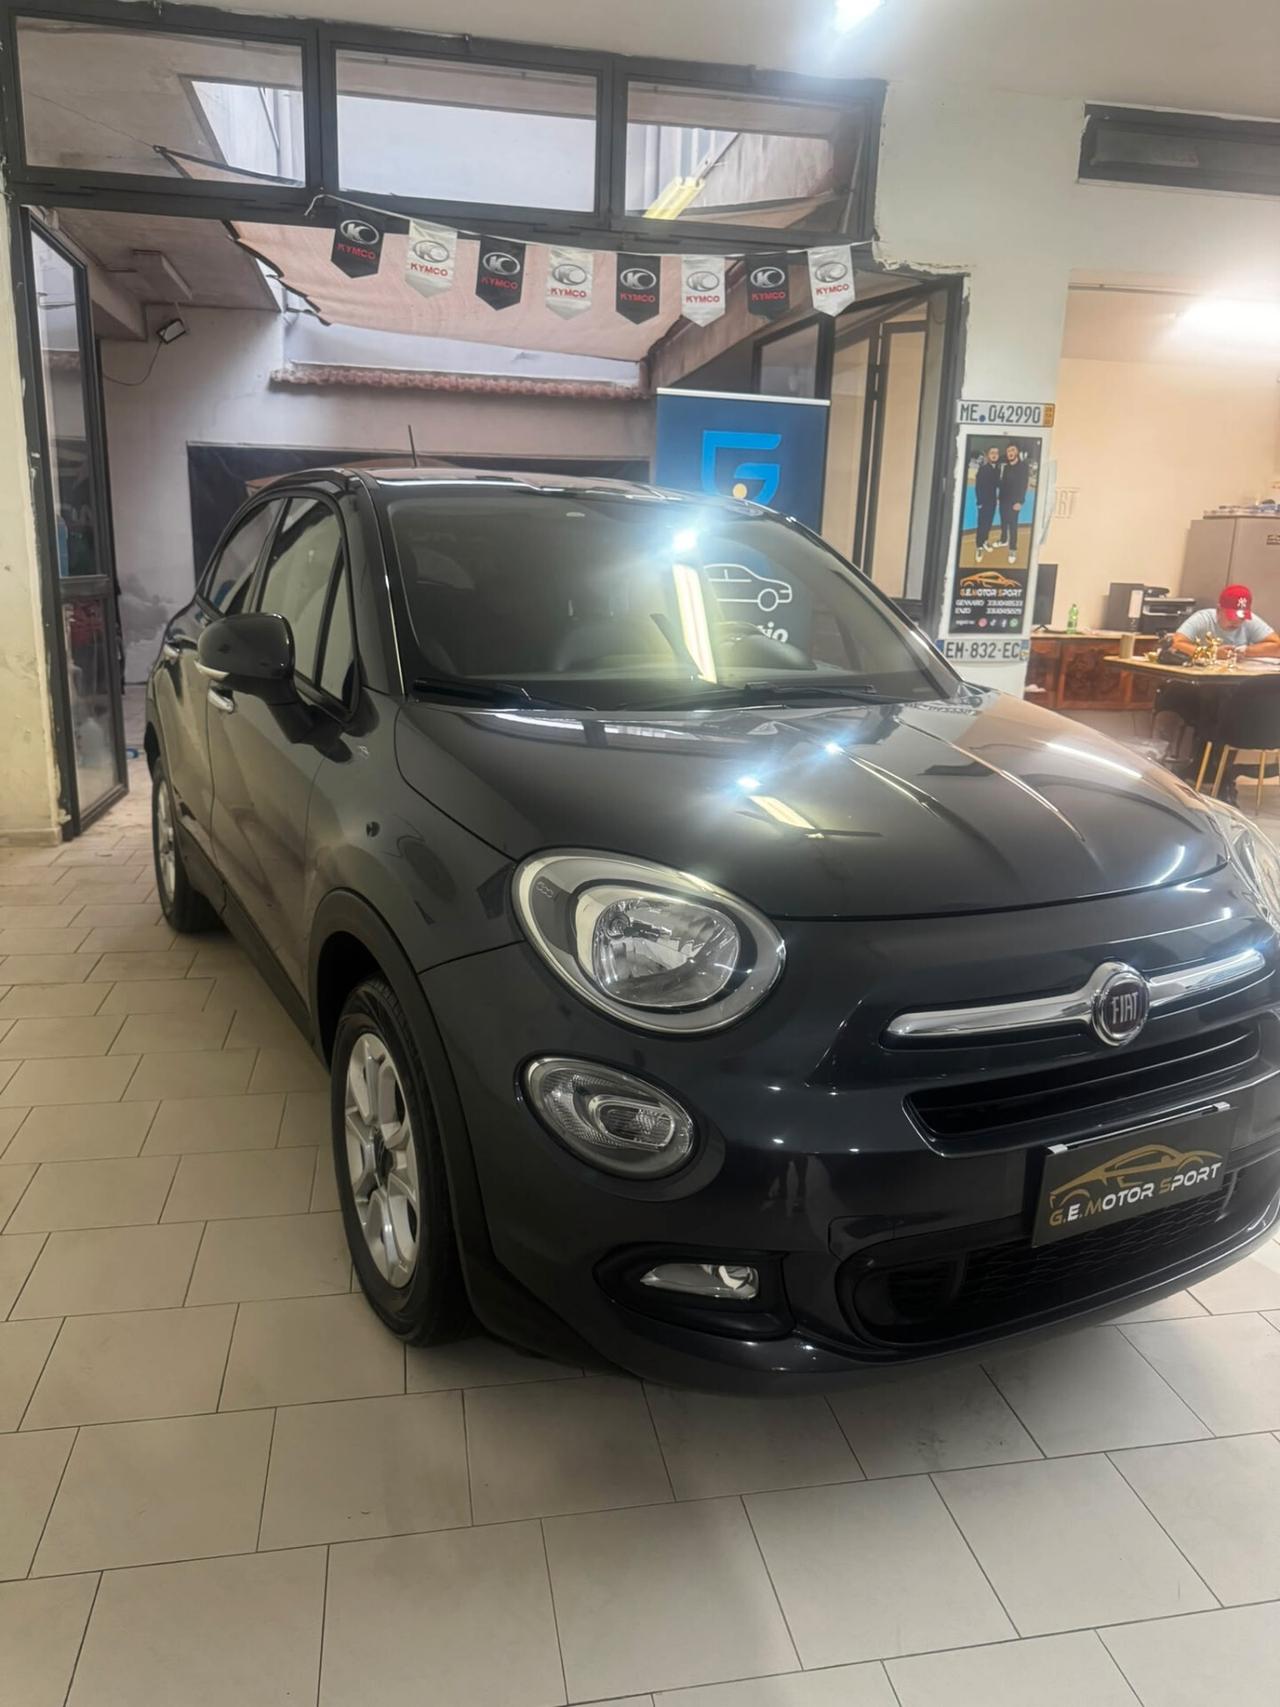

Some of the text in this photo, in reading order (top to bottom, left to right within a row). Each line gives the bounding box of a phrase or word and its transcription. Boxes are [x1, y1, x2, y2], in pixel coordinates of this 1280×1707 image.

[335, 243, 377, 261] KYMCO
[410, 261, 448, 277] KYMCO
[480, 277, 518, 290] KYMCO
[815, 283, 849, 296] KYMCO
[550, 287, 587, 298] KYMCO
[620, 291, 656, 303] KYMCO
[686, 294, 720, 303] KYMCO
[751, 291, 786, 301] KYMCO
[1112, 991, 1139, 1024] FIAT
[1158, 1162, 1222, 1195] SPORT
